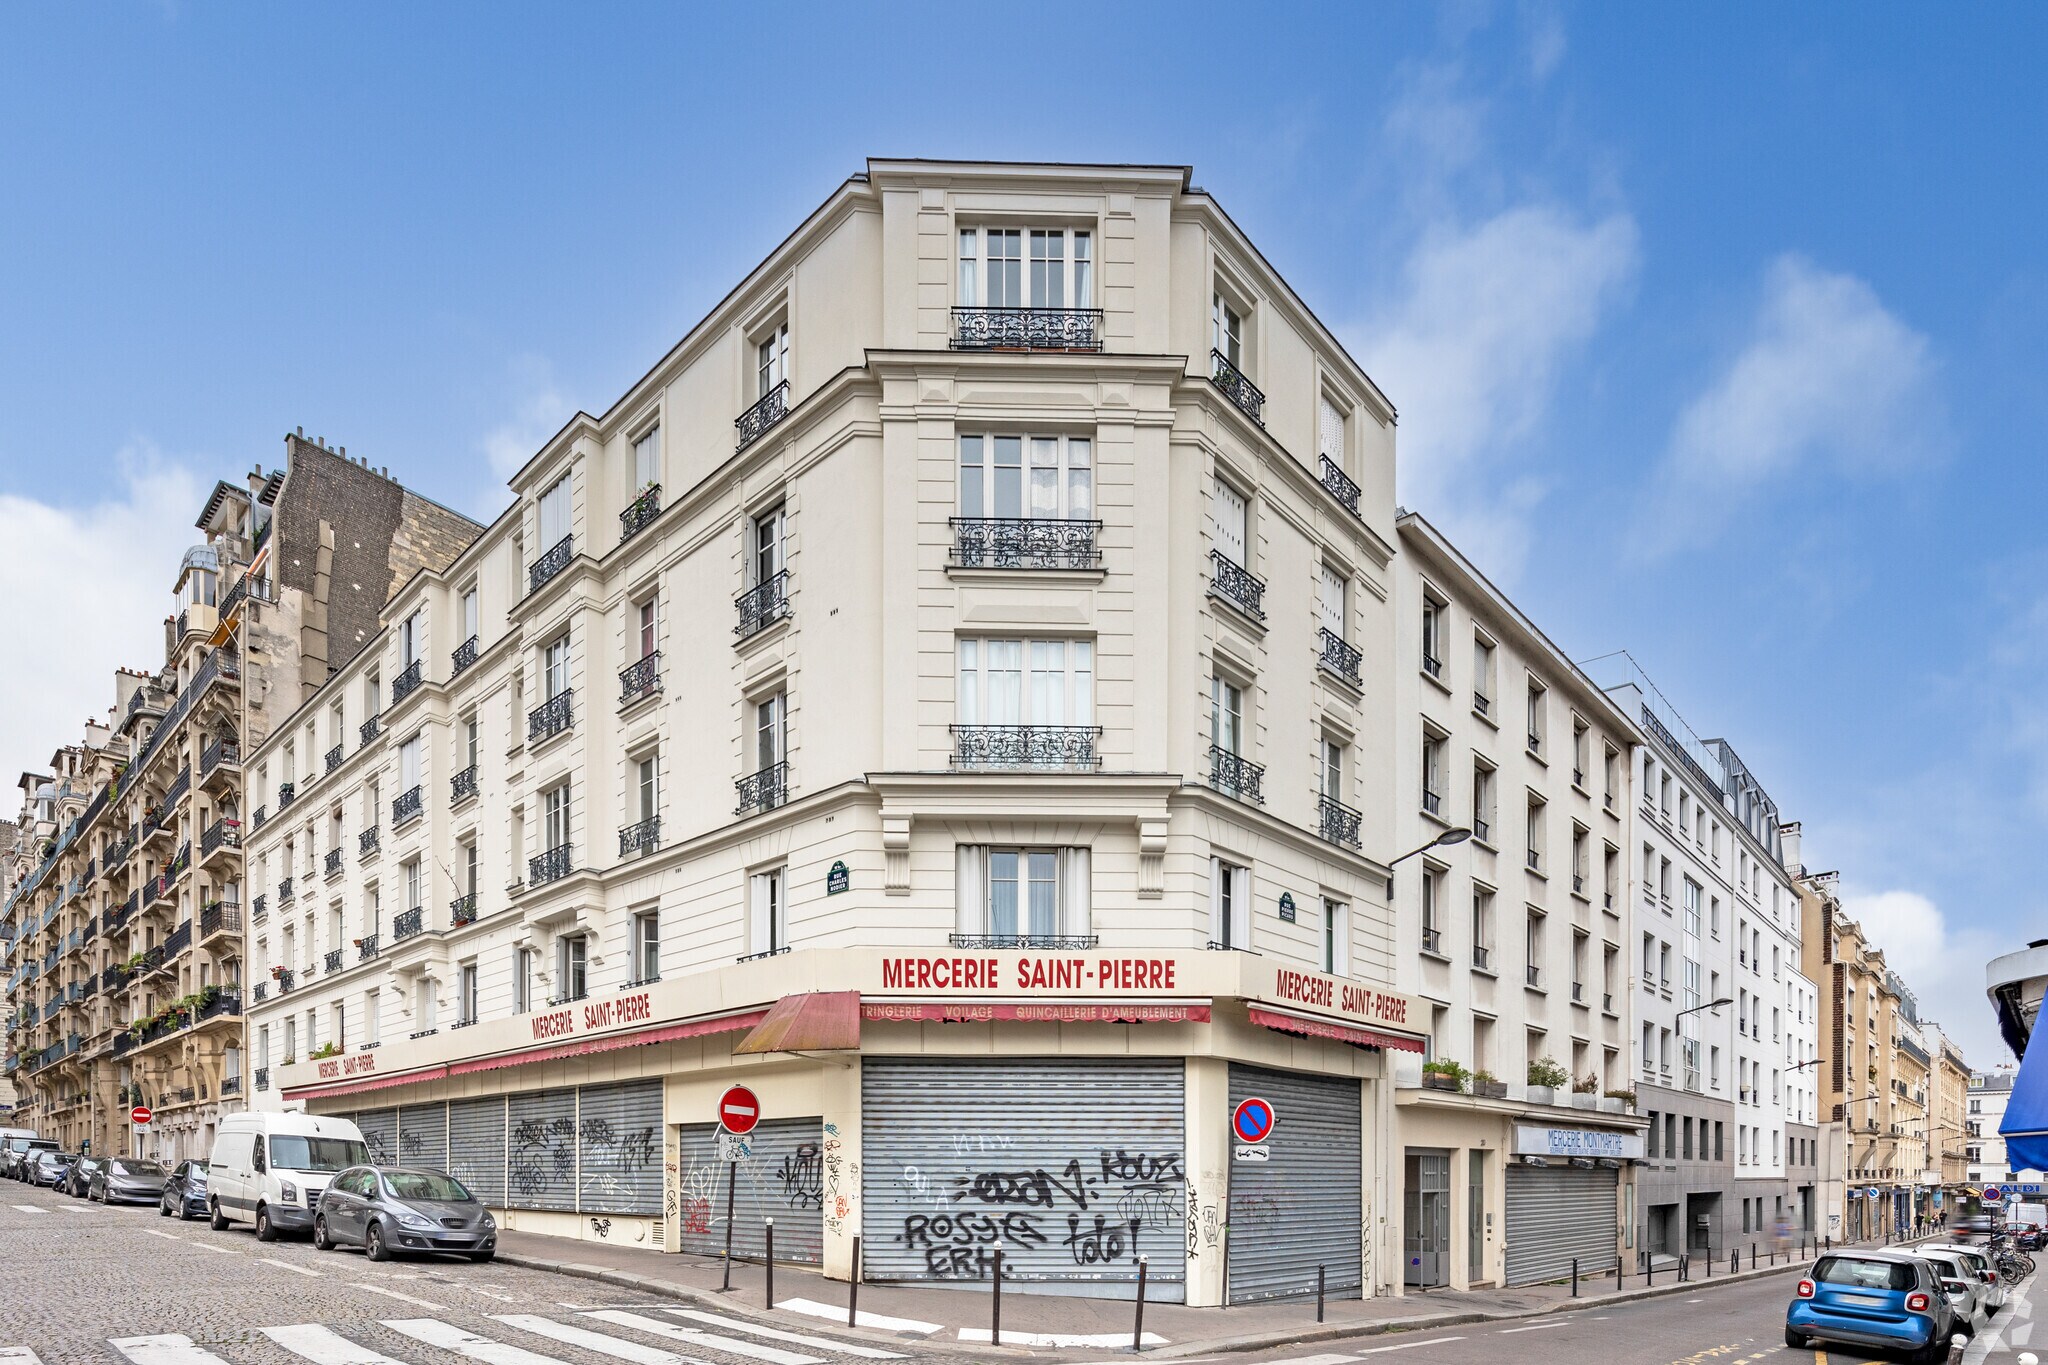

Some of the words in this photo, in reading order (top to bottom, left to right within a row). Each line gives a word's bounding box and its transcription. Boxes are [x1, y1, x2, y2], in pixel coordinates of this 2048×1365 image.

[882, 958, 998, 988] MERCERIE
[1017, 958, 1175, 989] SAINT-PIERRE
[1276, 969, 1333, 1007] MERCERIE
[1341, 984, 1407, 1024] SAINT-PIERRE
[531, 1009, 574, 1040] MERCERIE
[584, 993, 650, 1030] SAINT-PIERRE
[861, 1005, 922, 1017] TRINGLERIE
[945, 1006, 993, 1018] VOILAGE
[1015, 1006, 1096, 1019] QUINCAILLERIE
[1101, 1006, 1188, 1019] D'AMEUBLEMENT
[318, 1060, 340, 1079] MERCERIE
[343, 1053, 375, 1075] SAINT-PIERRE
[1548, 1130, 1581, 1148] MERCERIE
[1583, 1132, 1623, 1150] MONTMARTRE
[1999, 1184, 2040, 1193] ALDI
